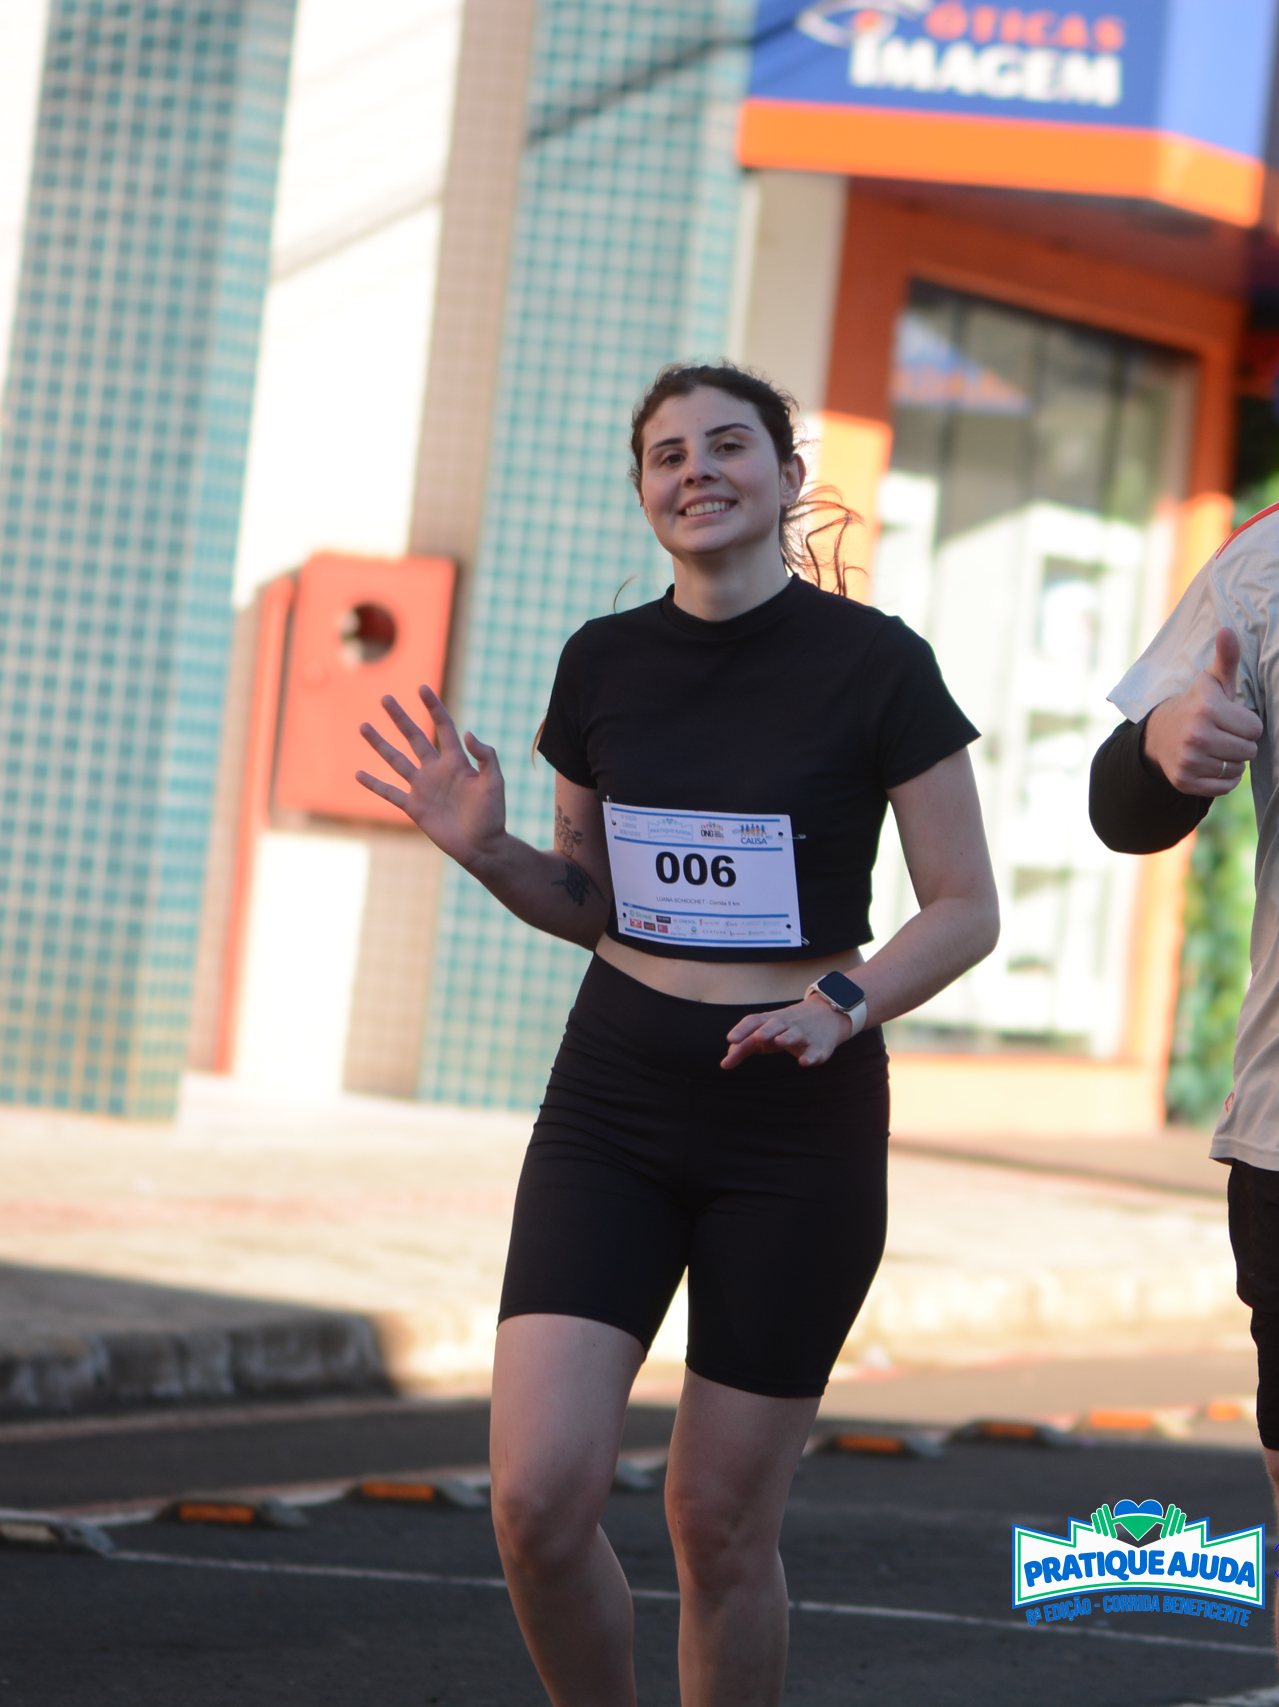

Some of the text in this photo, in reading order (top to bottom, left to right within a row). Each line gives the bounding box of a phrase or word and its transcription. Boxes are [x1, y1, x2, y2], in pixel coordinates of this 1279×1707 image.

[849, 36, 1122, 108] IMAGEM
[740, 837, 768, 845] CAUSA
[655, 851, 737, 888] 006
